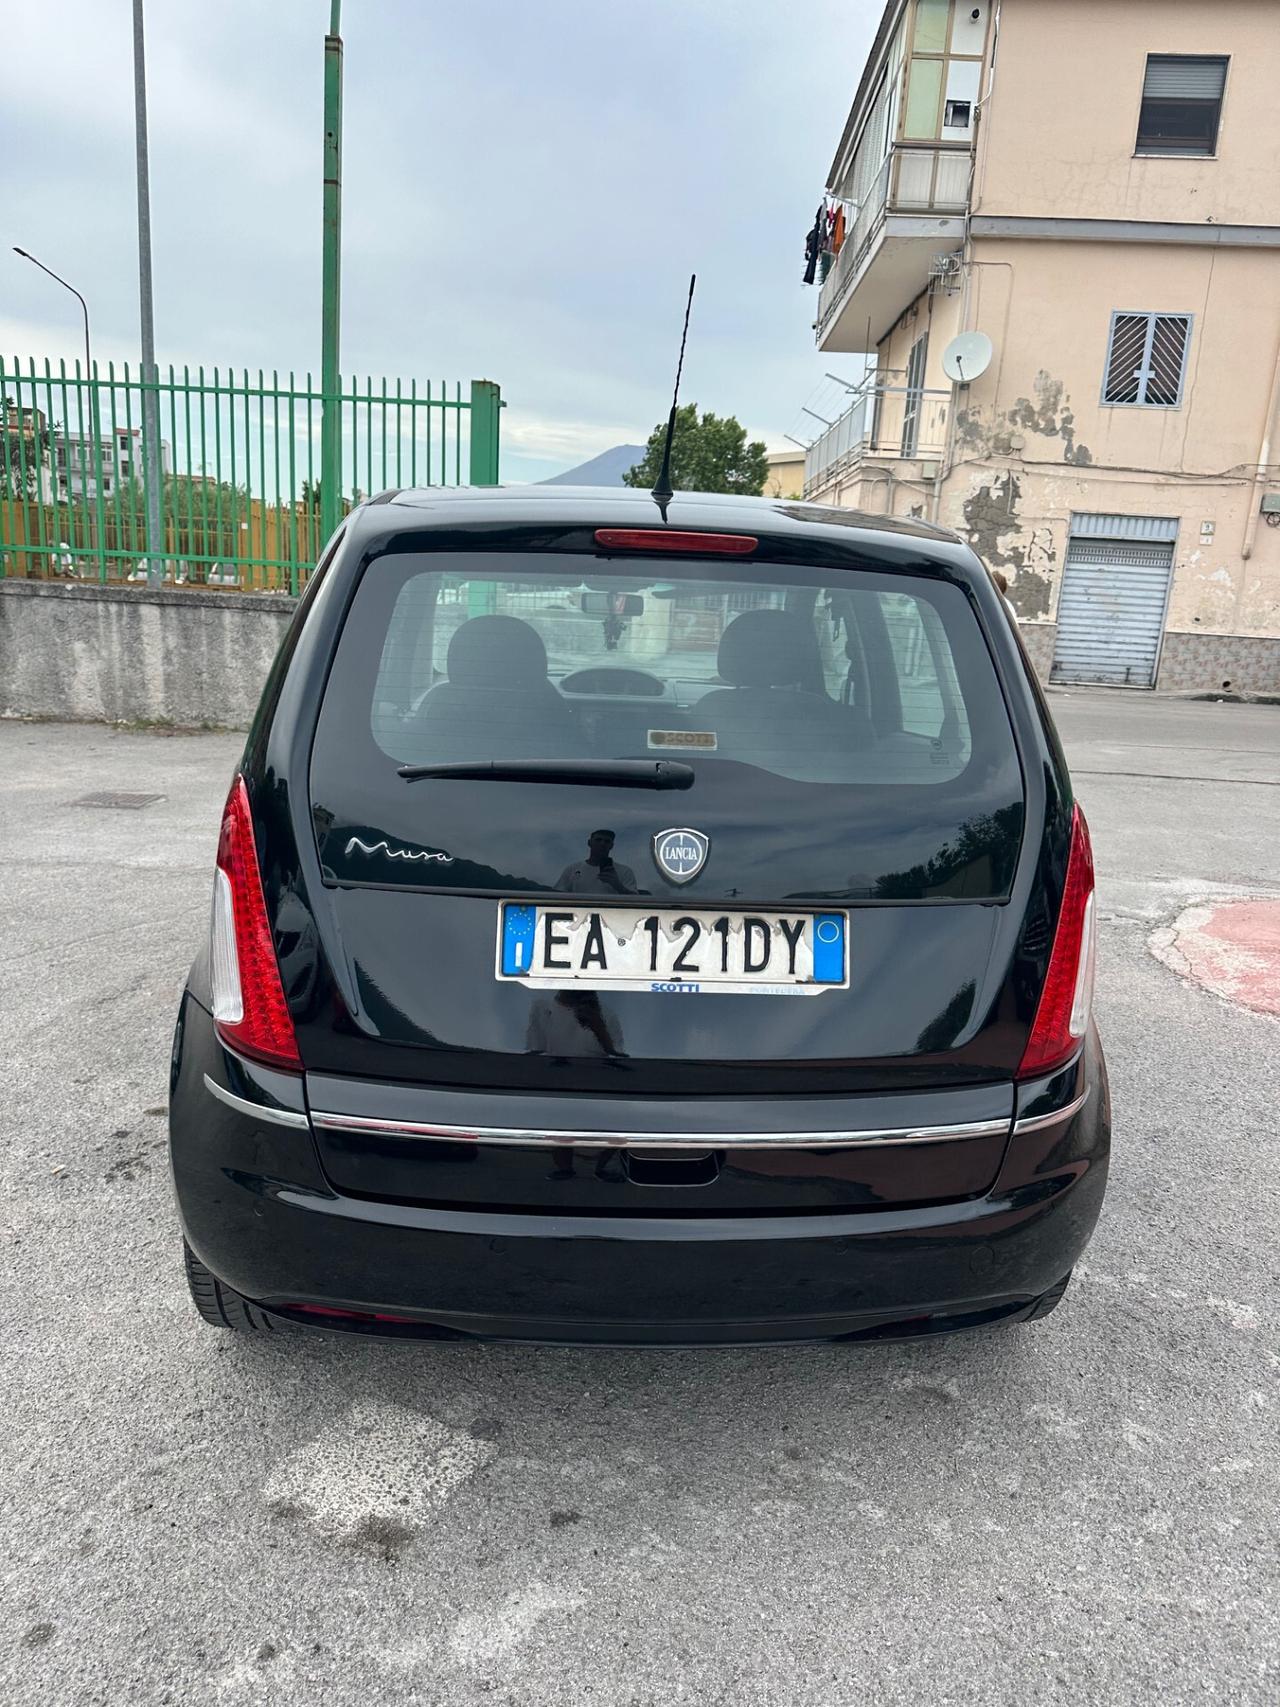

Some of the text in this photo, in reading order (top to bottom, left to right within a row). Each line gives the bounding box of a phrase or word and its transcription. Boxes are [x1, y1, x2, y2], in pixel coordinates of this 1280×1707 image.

[665, 846, 698, 860] LANCIA
[543, 912, 806, 975] EA 121DY
[650, 982, 700, 993] SCOTTI
